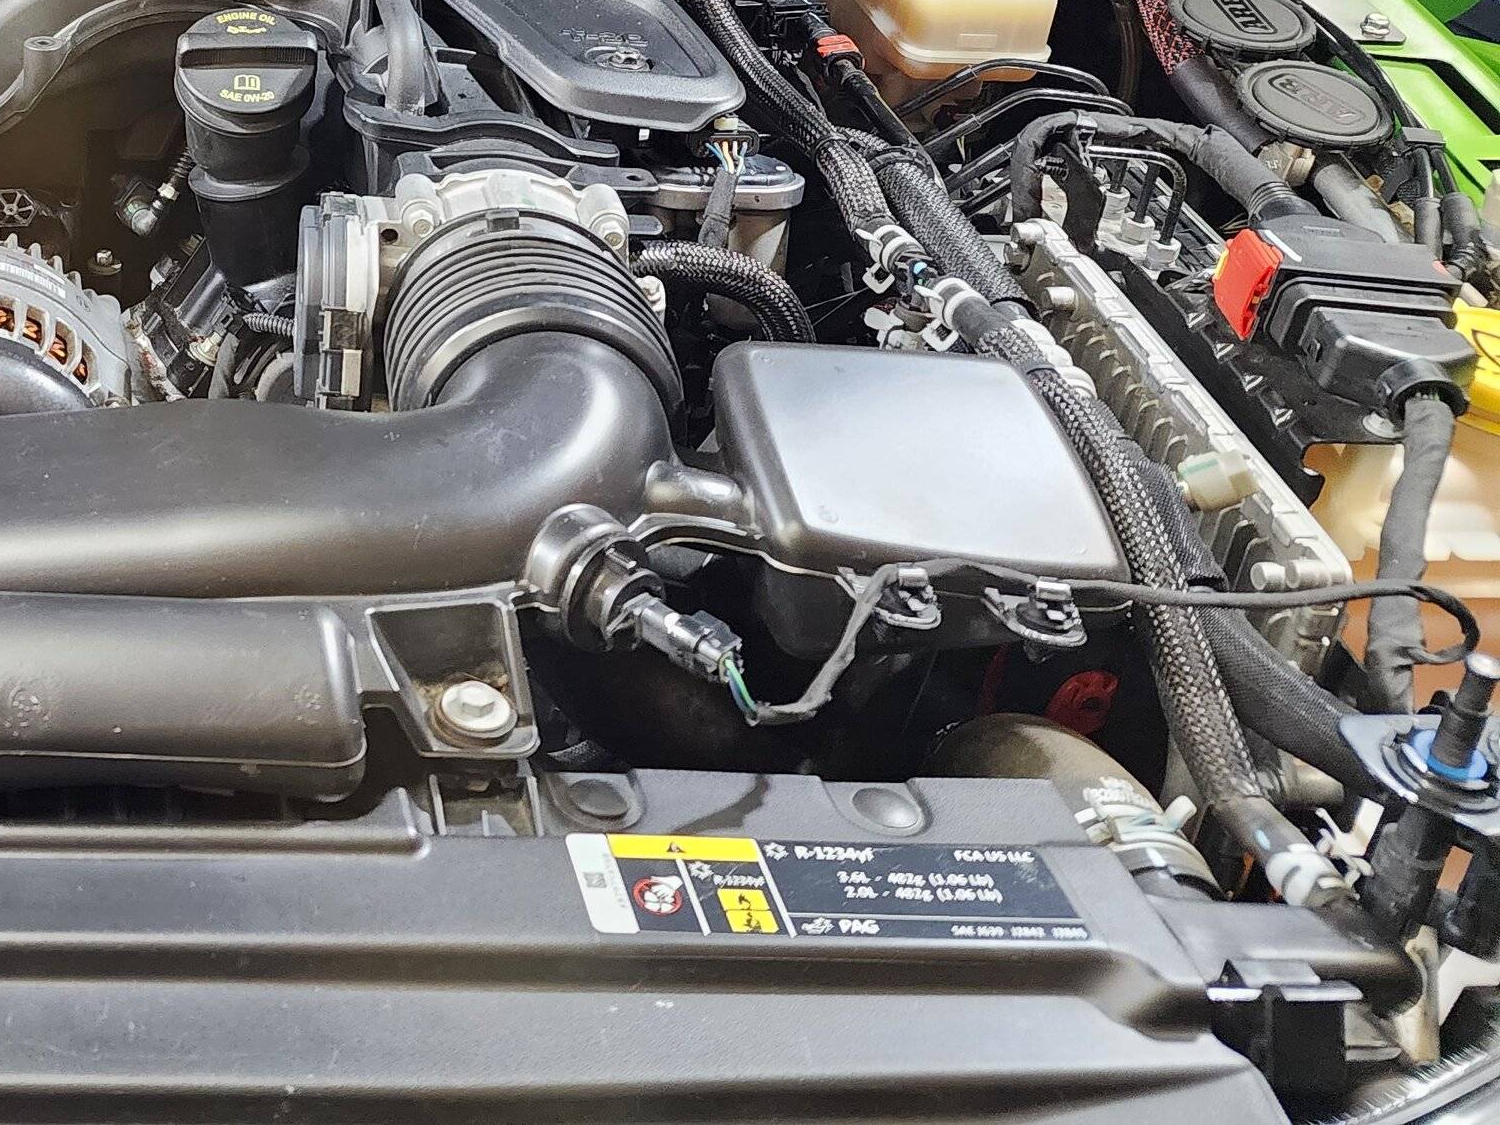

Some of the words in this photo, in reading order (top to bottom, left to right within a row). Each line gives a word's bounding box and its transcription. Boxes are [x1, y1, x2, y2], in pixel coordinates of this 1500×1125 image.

[216, 11, 258, 24] ENGINE
[258, 13, 277, 26] OIL
[220, 89, 242, 102] SAE
[953, 849, 985, 862] FCA
[838, 919, 880, 934] PAG
